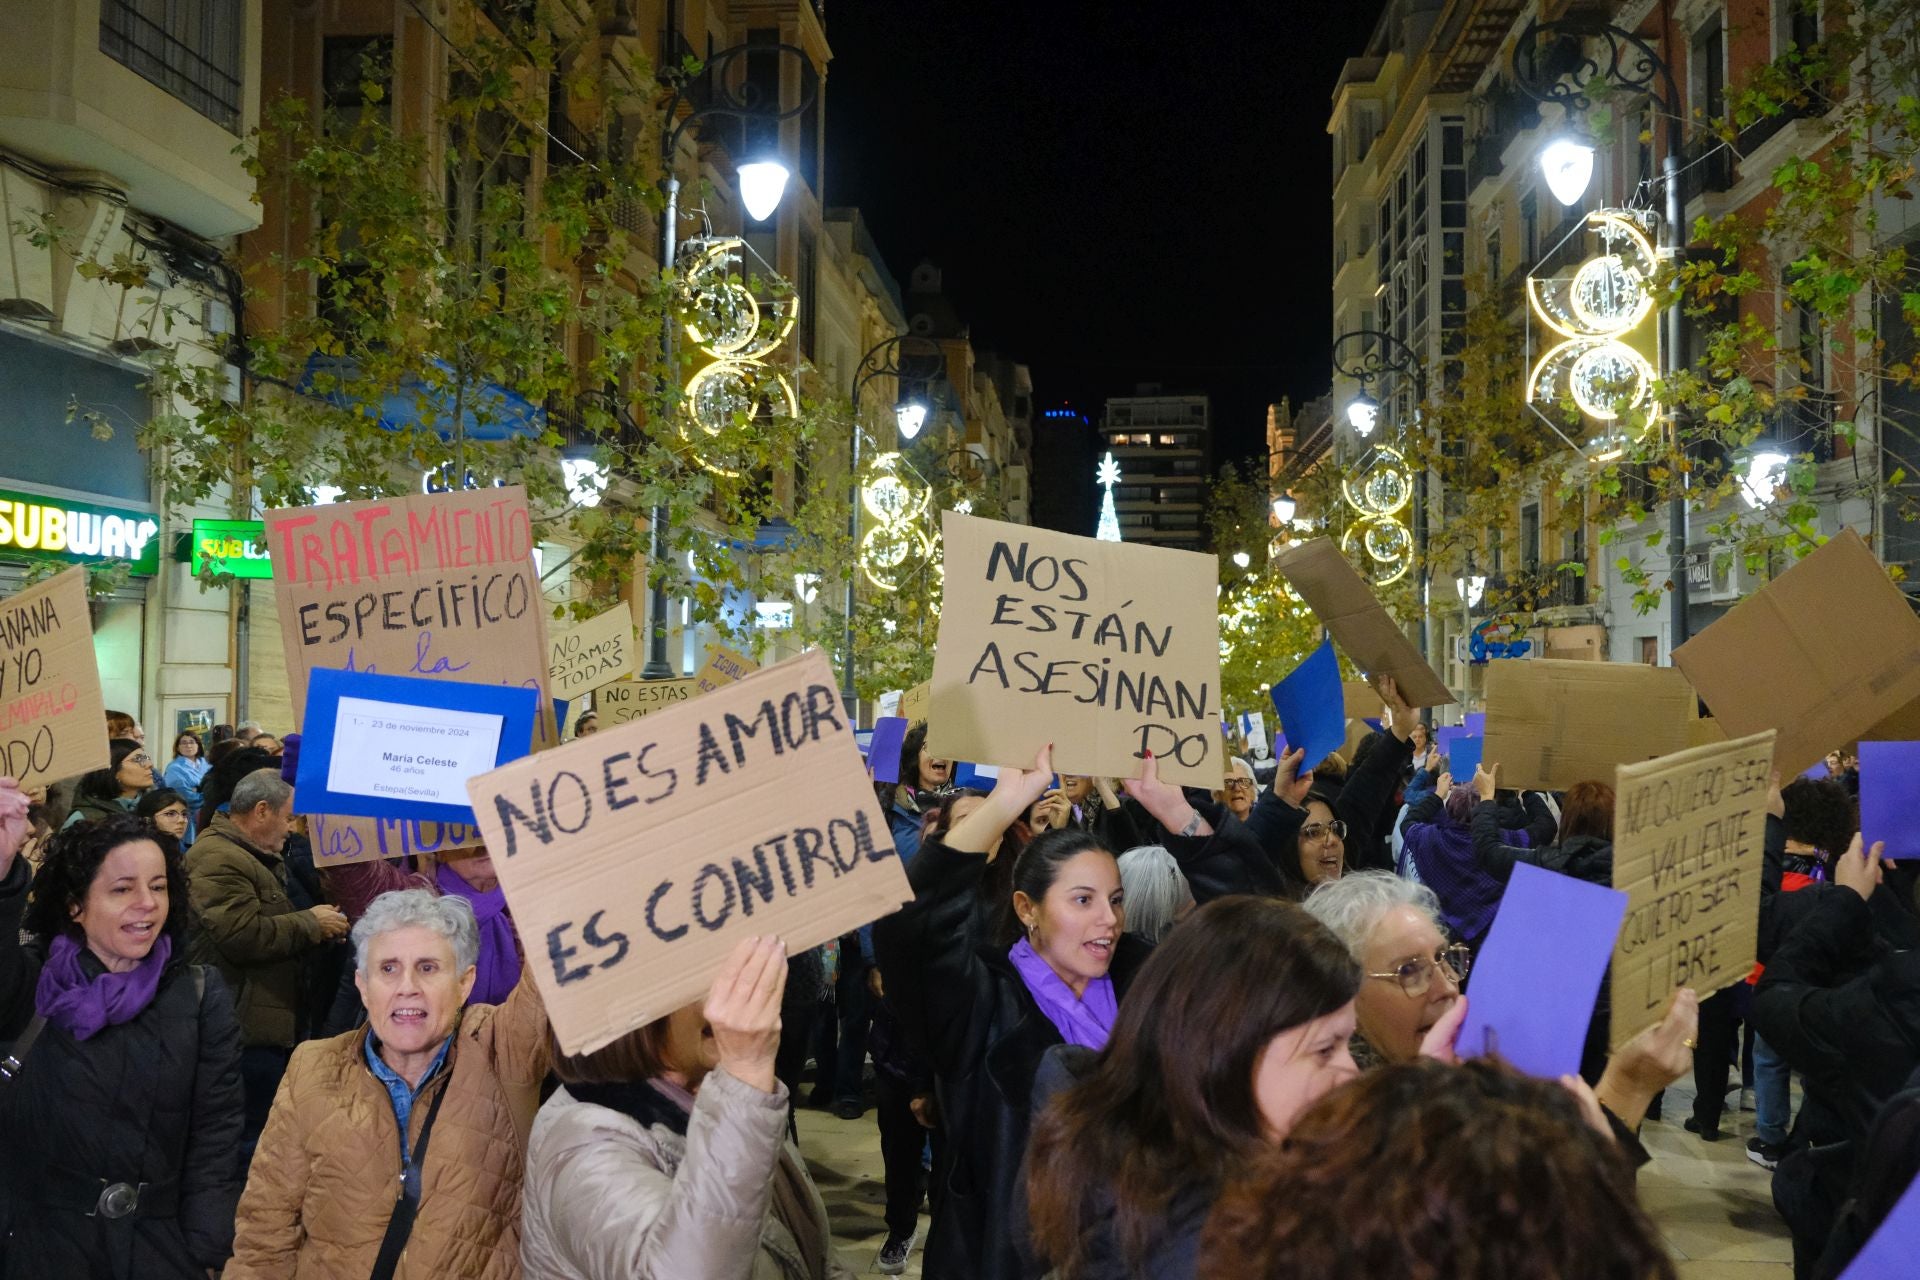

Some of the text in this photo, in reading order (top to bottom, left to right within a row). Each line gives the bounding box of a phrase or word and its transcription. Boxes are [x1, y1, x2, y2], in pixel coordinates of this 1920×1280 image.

[0, 500, 158, 561] SUBWAY
[198, 539, 271, 560] SUBW
[273, 499, 532, 593] TRATAMIENTO
[986, 541, 1089, 601] NOS
[990, 594, 1173, 657] ESTÁN
[410, 631, 470, 674] la
[548, 634, 622, 678] ESTAMOS
[552, 635, 581, 664] NO
[558, 649, 623, 689] TODAS
[606, 687, 630, 703] NO
[638, 685, 688, 701] ESTAS
[371, 720, 384, 729] 23
[386, 722, 397, 730] de
[399, 724, 446, 735] noviembre
[448, 728, 470, 737] 2024
[1133, 724, 1208, 767] DO
[390, 765, 425, 775] 46 años
[416, 755, 458, 768] Celeste
[494, 684, 843, 858] NO ES AMOR
[373, 783, 440, 799] Estepa(Sevilla)
[1654, 766, 1725, 828] QUIERO
[1731, 759, 1769, 798] SER
[1653, 810, 1750, 892] VALIENTE
[547, 810, 896, 987] ES CONTROL
[1622, 868, 1742, 954] QUIERO SER
[1646, 925, 1724, 1009] LIBRE
